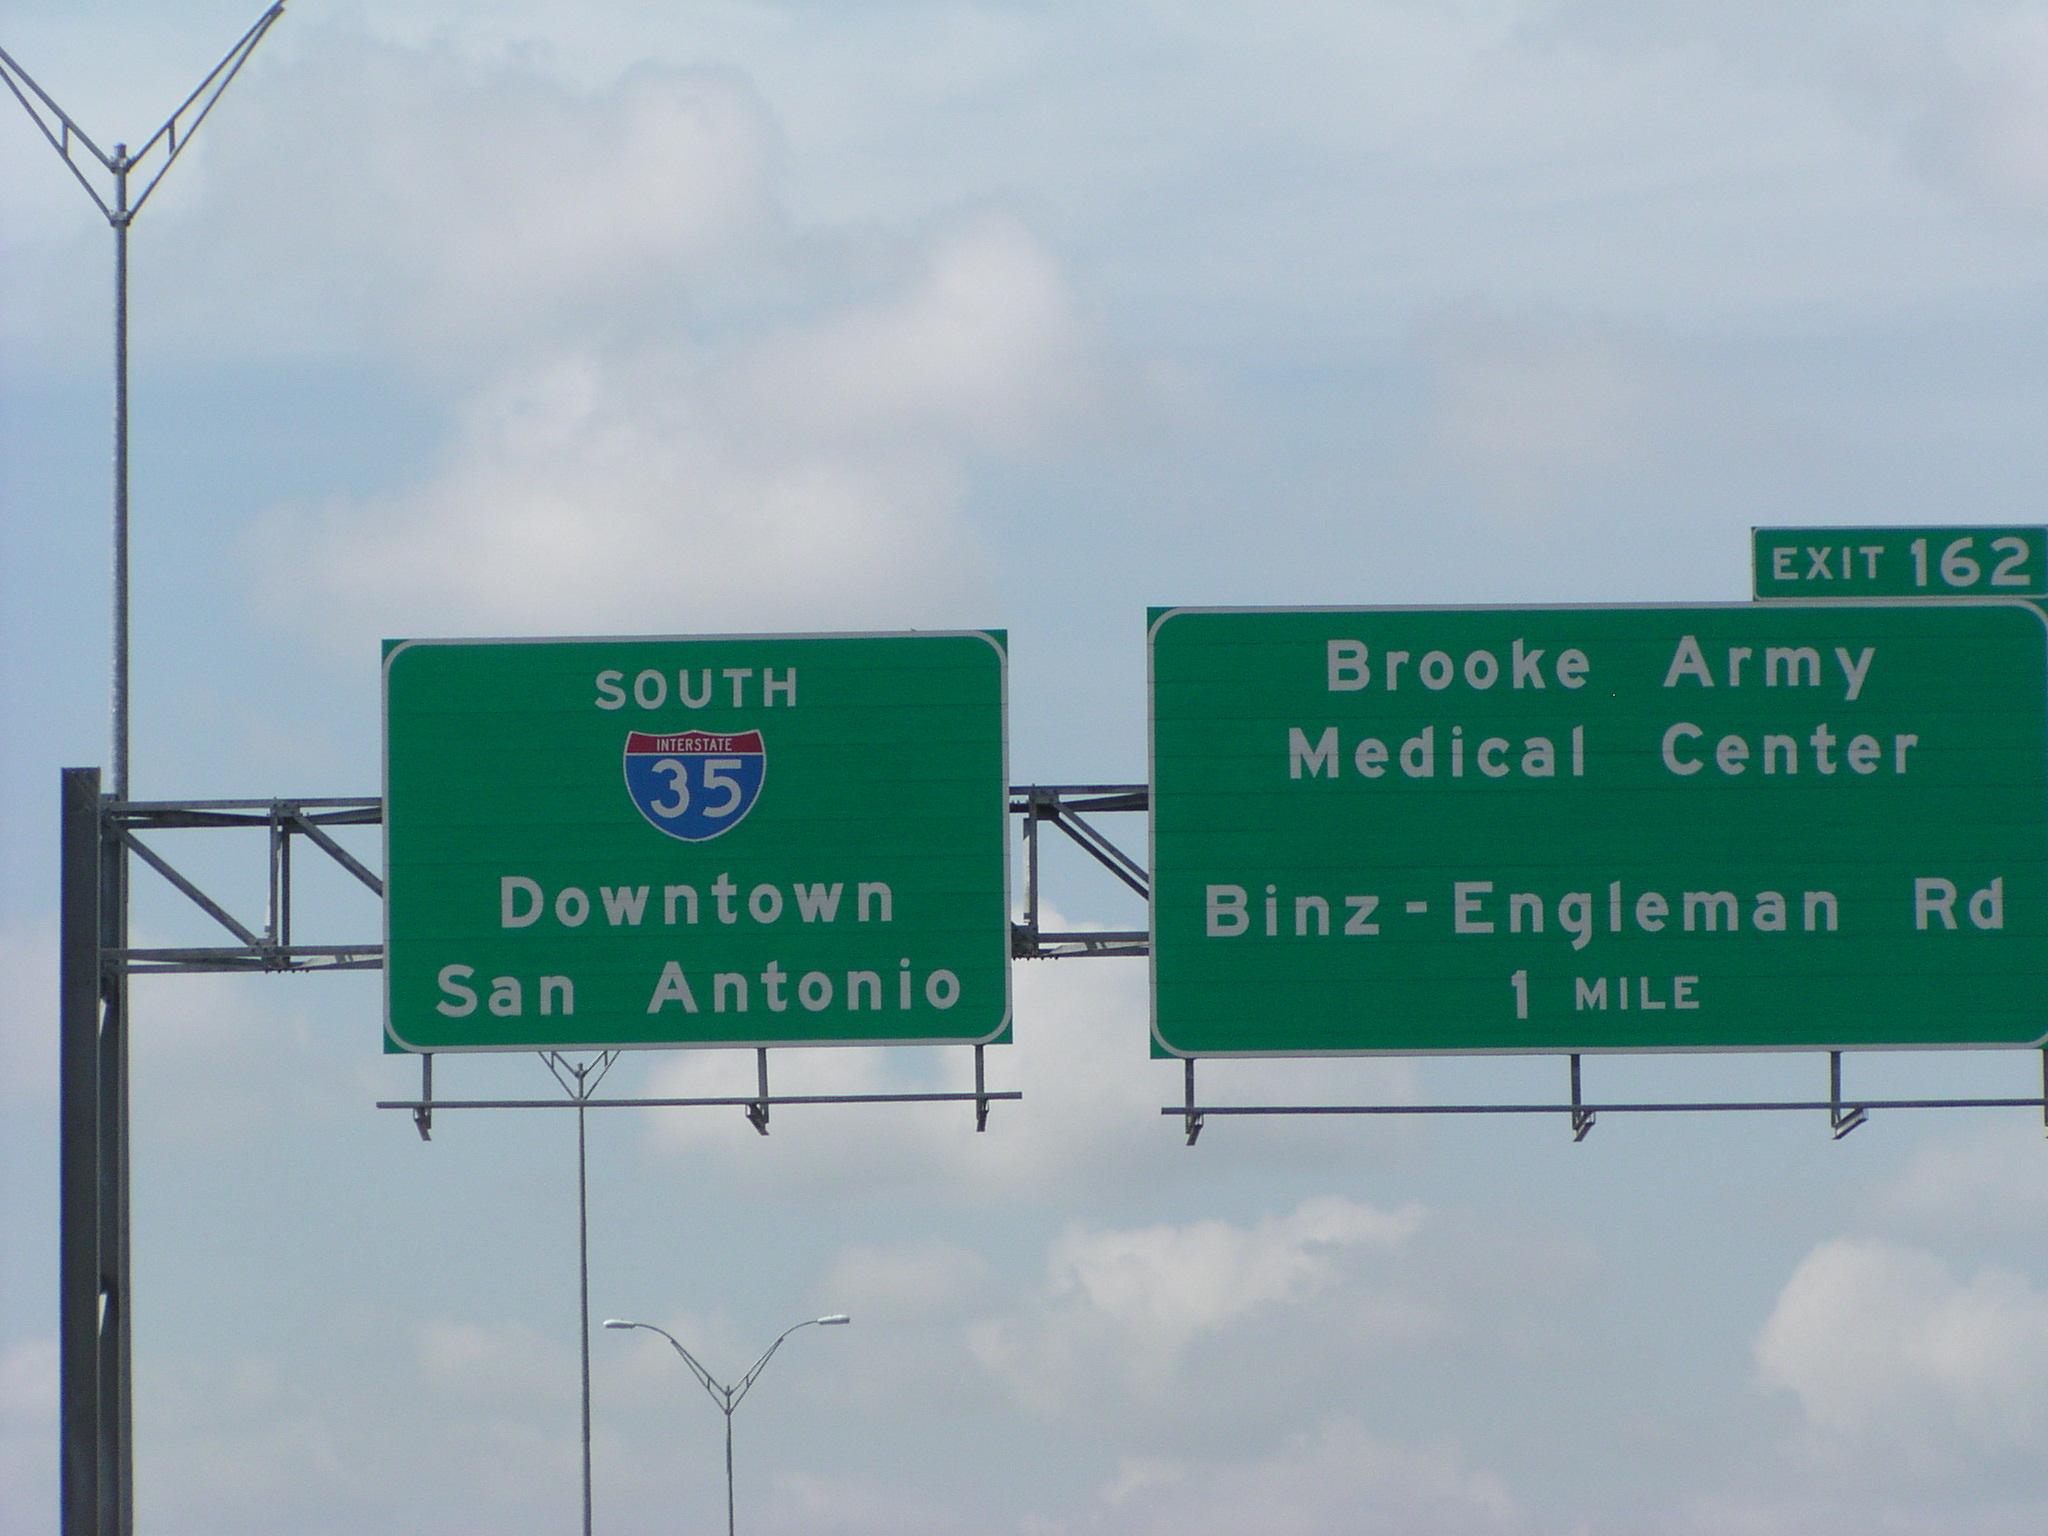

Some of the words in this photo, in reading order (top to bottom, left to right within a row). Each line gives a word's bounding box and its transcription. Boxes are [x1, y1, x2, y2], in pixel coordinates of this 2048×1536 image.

[1774, 547, 1883, 579] EXIT
[1912, 538, 2029, 586] 162
[596, 668, 795, 709] SOUTH
[1328, 639, 1588, 690] Brooke
[1665, 636, 1874, 699] Army
[655, 737, 733, 752] INTERSTATE
[1290, 726, 1583, 778] Medical
[1663, 723, 1917, 775] Center
[651, 759, 741, 817] 35
[502, 873, 891, 927] Downtown
[1916, 878, 2002, 929] Rd
[437, 965, 573, 1016] San
[648, 959, 959, 1012] Antonio
[1512, 971, 1527, 1018] 1
[1576, 977, 1698, 1009] MILE
